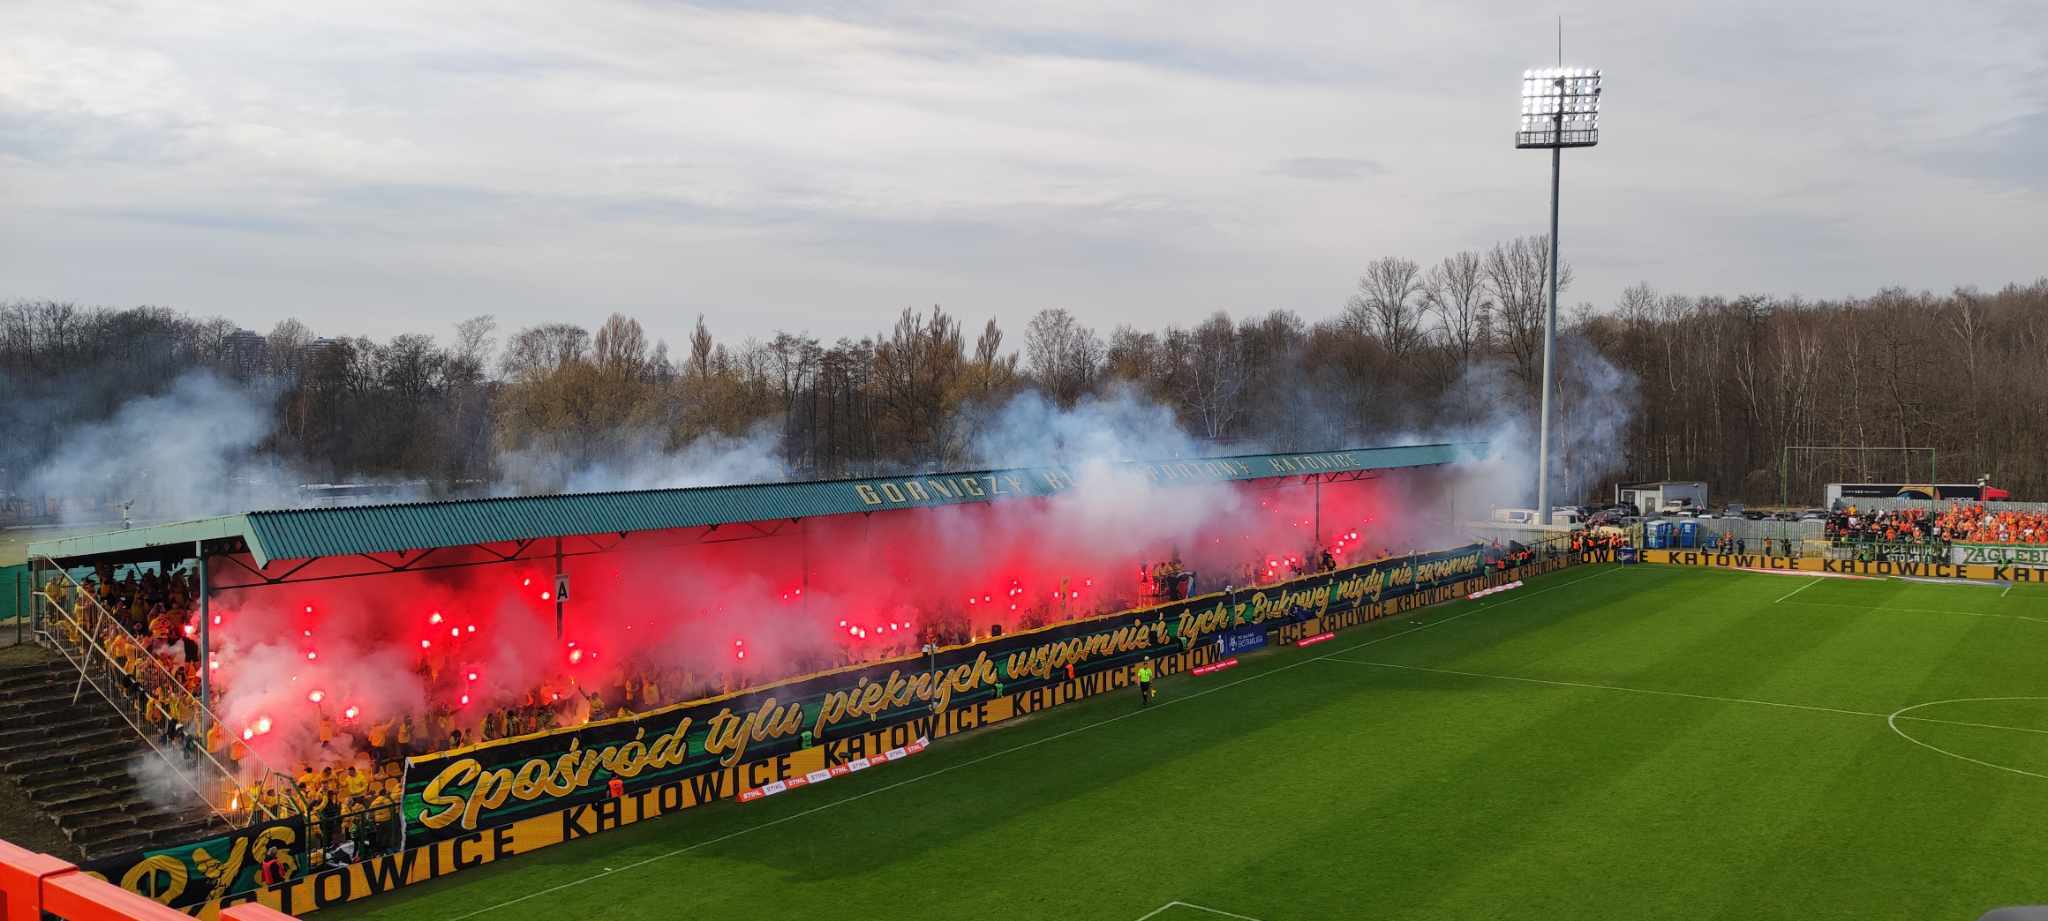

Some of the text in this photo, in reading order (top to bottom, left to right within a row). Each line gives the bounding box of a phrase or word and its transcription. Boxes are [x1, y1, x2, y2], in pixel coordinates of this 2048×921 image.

[1269, 454, 1361, 474] KATOWICE
[1669, 551, 1799, 570] KATOWICE
[1824, 559, 1967, 578] KATOWICE
[557, 581, 568, 600] A
[419, 717, 693, 829] Spośród
[704, 698, 803, 767] tylu
[814, 651, 997, 737] pięknych
[1177, 601, 1229, 649] tych
[1235, 603, 1247, 625] z
[1252, 579, 1333, 624] Bukowej
[1337, 568, 1385, 607] nigdy
[1389, 561, 1413, 587] nie
[563, 755, 791, 840] KATOWICE
[824, 702, 989, 769] KATOWICE
[1013, 664, 1139, 718] KATOWICE
[1319, 602, 1388, 632] KATOWICE
[1397, 584, 1456, 614] KATOWICE
